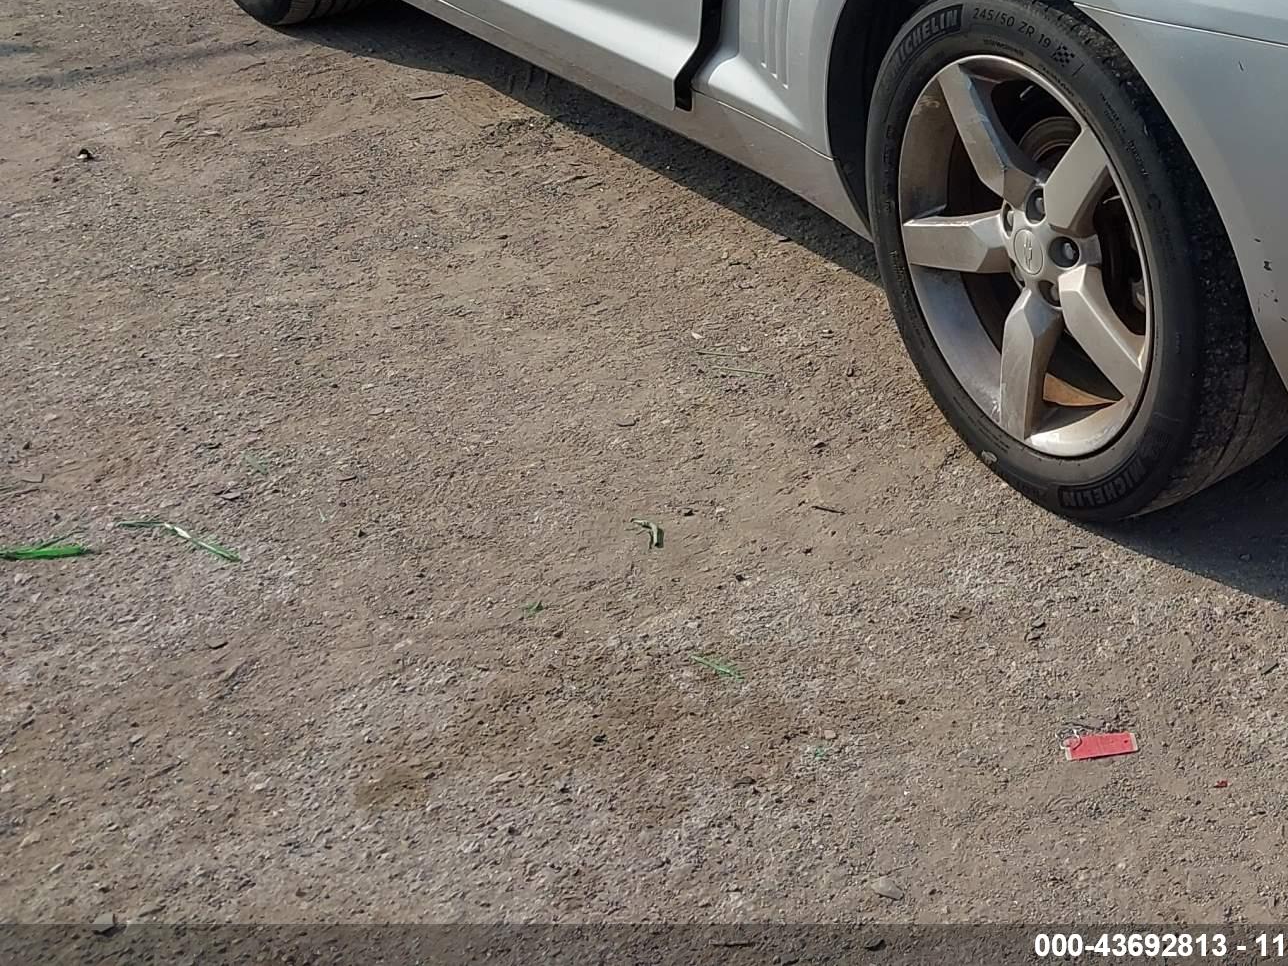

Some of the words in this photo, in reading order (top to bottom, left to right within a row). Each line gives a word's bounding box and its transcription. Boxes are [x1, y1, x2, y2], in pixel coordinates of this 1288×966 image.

[972, 7, 1015, 28] 245/50
[1018, 22, 1035, 37] ZR
[1037, 29, 1052, 49] 19
[1060, 458, 1146, 507] MICHELIN
